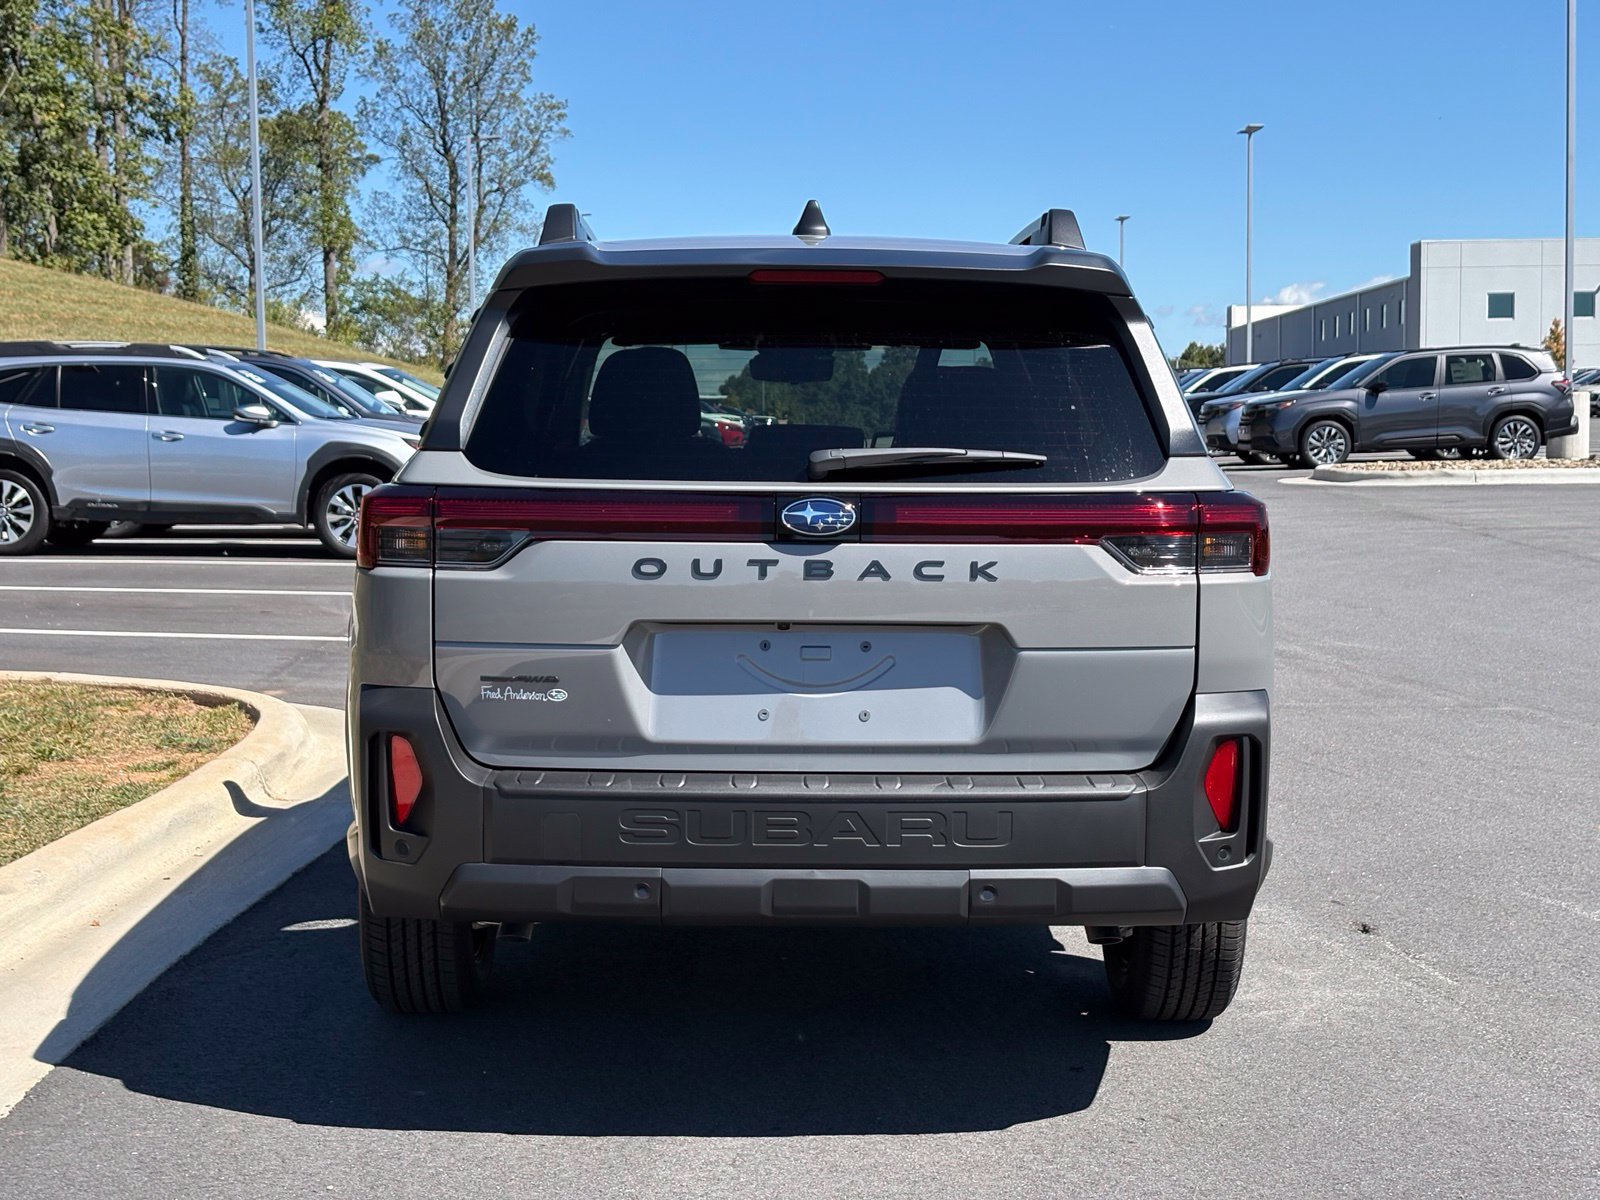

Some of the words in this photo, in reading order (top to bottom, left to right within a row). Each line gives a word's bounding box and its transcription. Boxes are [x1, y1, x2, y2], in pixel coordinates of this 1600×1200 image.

[632, 557, 998, 582] OUTBACK
[480, 685, 503, 701] Fred
[504, 686, 548, 702] Anderson
[618, 808, 1014, 847] SUBARU
